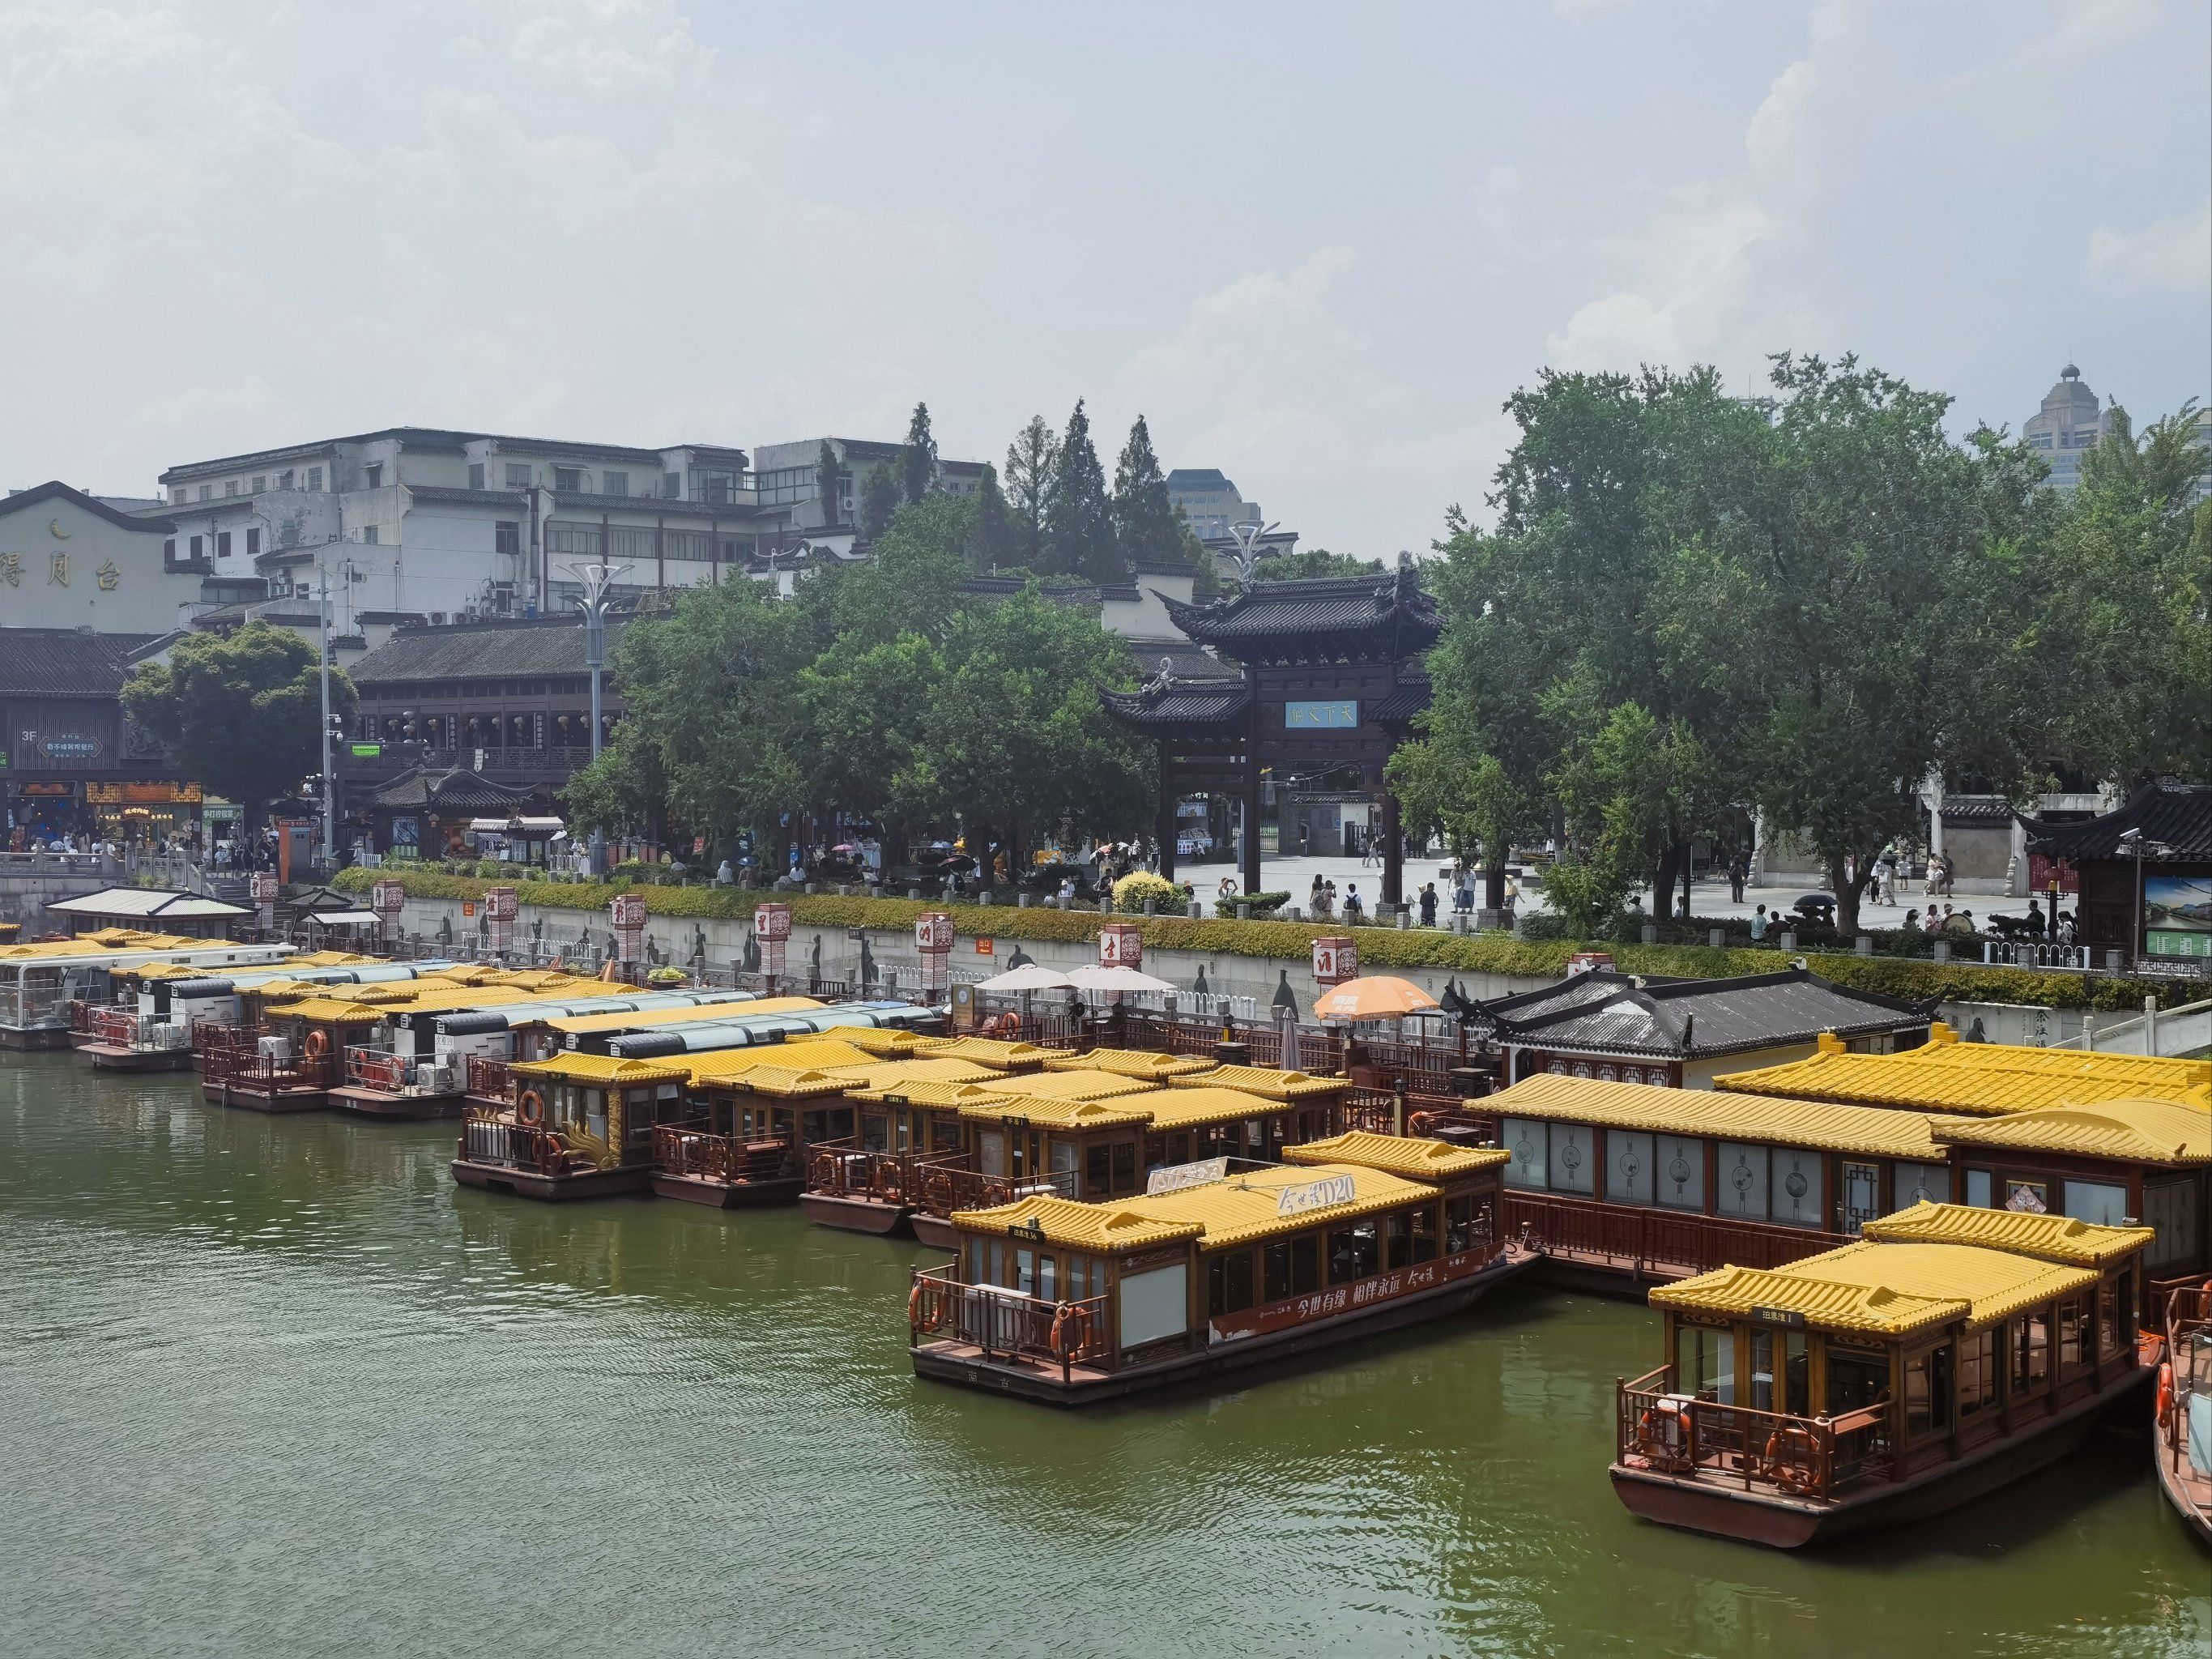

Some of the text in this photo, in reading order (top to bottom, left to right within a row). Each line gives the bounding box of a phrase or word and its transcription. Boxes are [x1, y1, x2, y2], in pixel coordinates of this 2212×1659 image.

[21, 731, 37, 741] 3F
[1297, 1289, 1346, 1319] 今世有缘
[1353, 1274, 1401, 1304] 相伴永远
